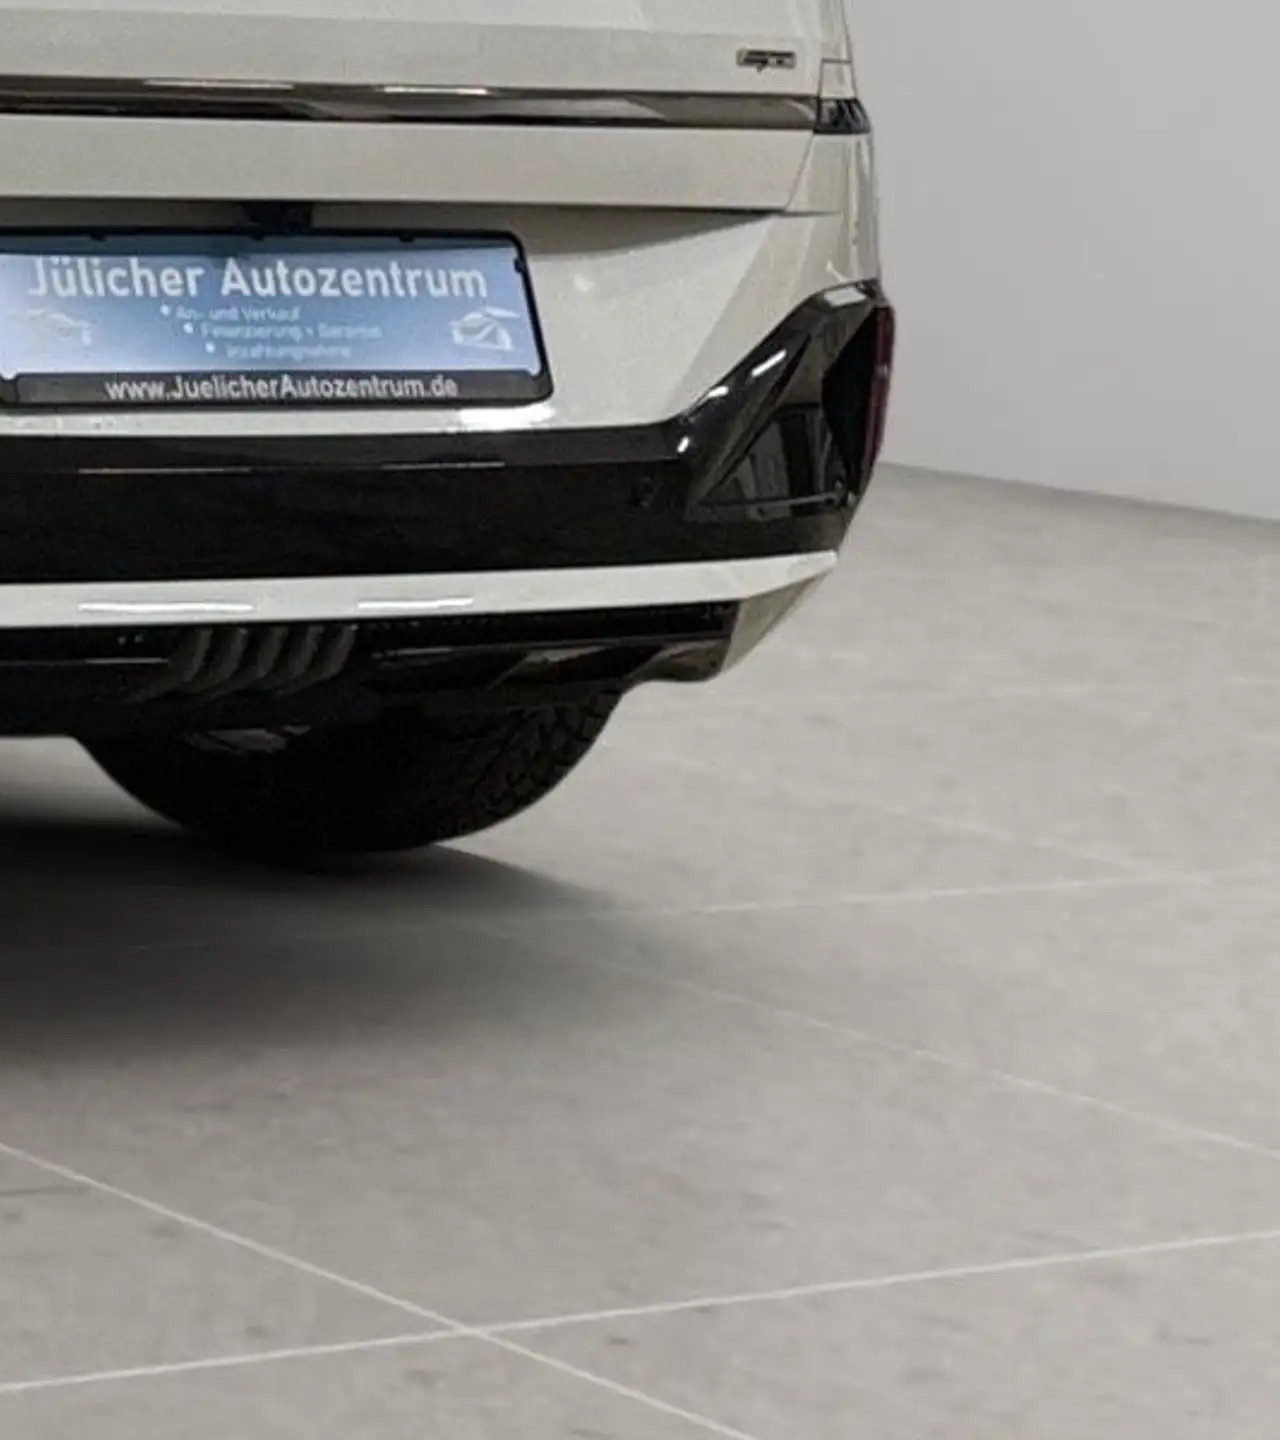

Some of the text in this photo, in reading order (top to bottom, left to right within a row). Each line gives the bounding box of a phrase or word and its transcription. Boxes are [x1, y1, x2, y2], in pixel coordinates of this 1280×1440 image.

[27, 256, 489, 298] Jülicher Autozentrum
[105, 373, 459, 400] www.JuelicherAutozentrum.de
